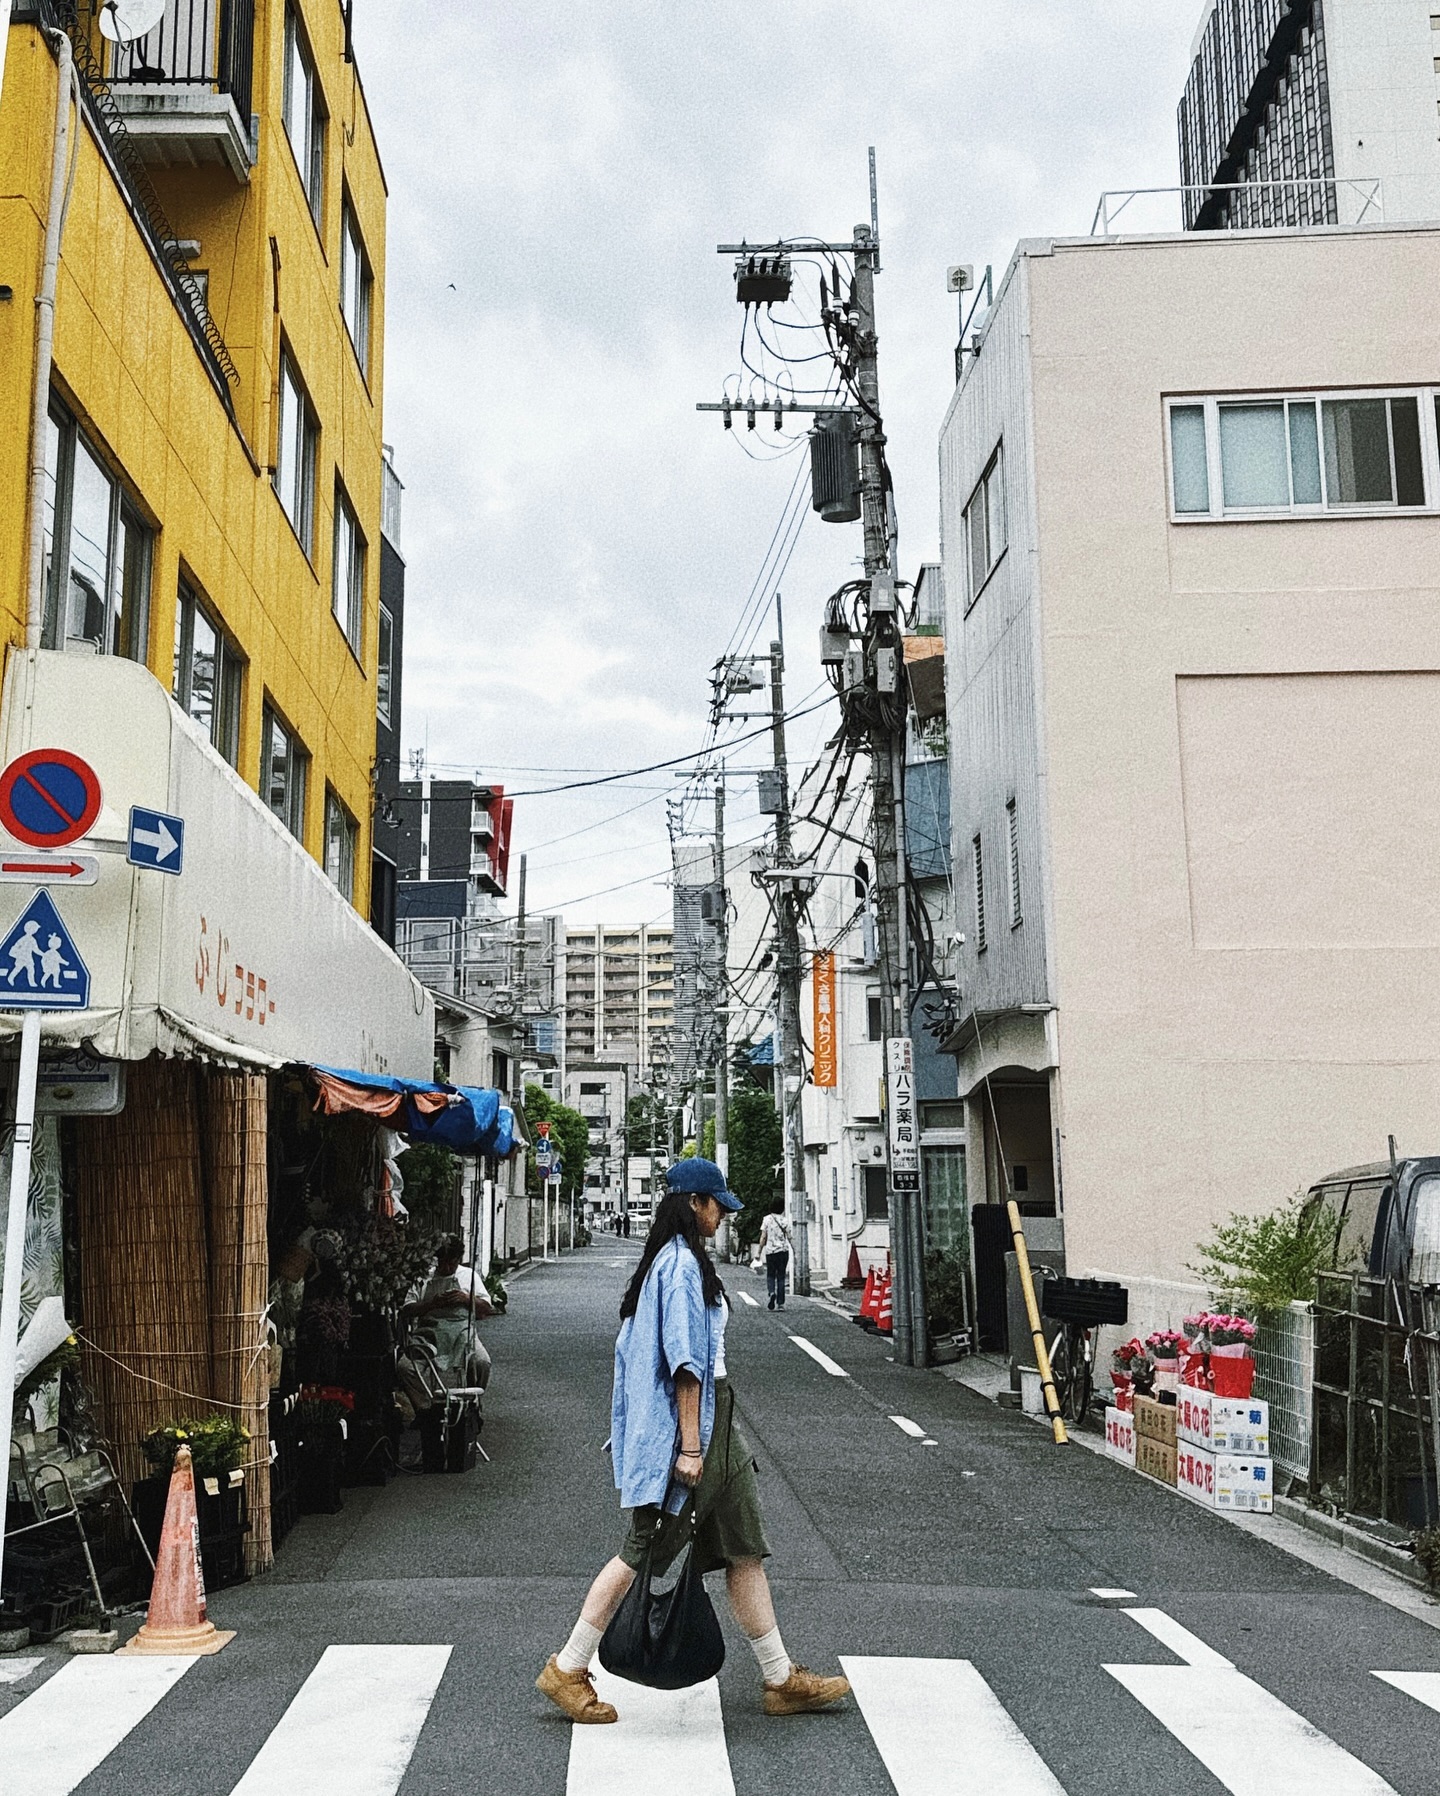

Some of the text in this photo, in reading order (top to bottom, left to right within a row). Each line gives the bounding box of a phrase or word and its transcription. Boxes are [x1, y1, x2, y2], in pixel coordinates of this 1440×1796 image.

[893, 1041, 901, 1072] クスリ
[895, 1074, 912, 1143] ハラ薬局
[1249, 1409, 1262, 1425] 菊
[1253, 1466, 1266, 1481] 菊
